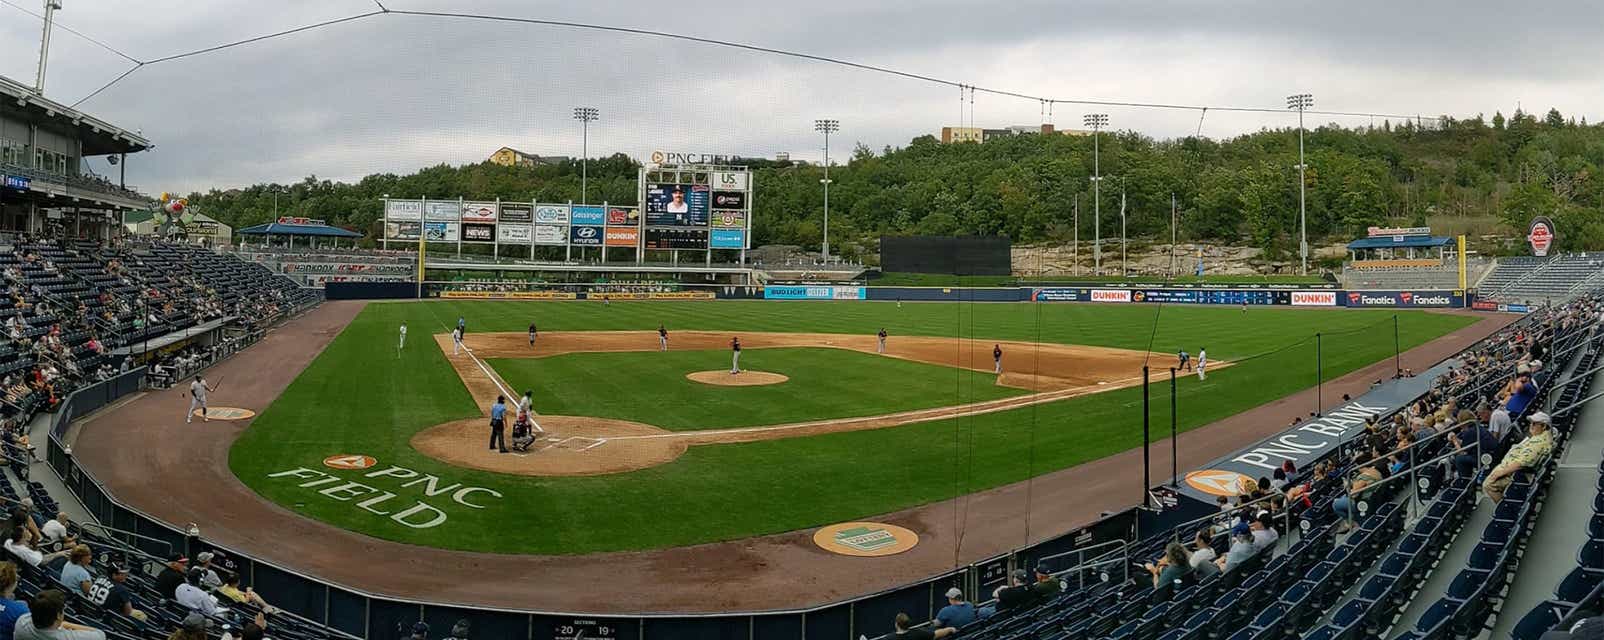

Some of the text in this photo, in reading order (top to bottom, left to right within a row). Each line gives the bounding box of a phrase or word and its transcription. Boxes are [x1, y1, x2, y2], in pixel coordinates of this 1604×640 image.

[666, 152, 742, 165] PNC FIELD
[572, 210, 603, 220] Geisinger
[1092, 291, 1130, 300] DUNKIN'
[1293, 294, 1335, 304] DUNKIN'
[1361, 295, 1397, 305] Fanatics
[1413, 295, 1451, 305] Fanatics
[1232, 401, 1389, 470] PNC BANK
[365, 464, 503, 509] PNC
[268, 466, 447, 529] FIELD
[560, 625, 609, 636] 20 19
